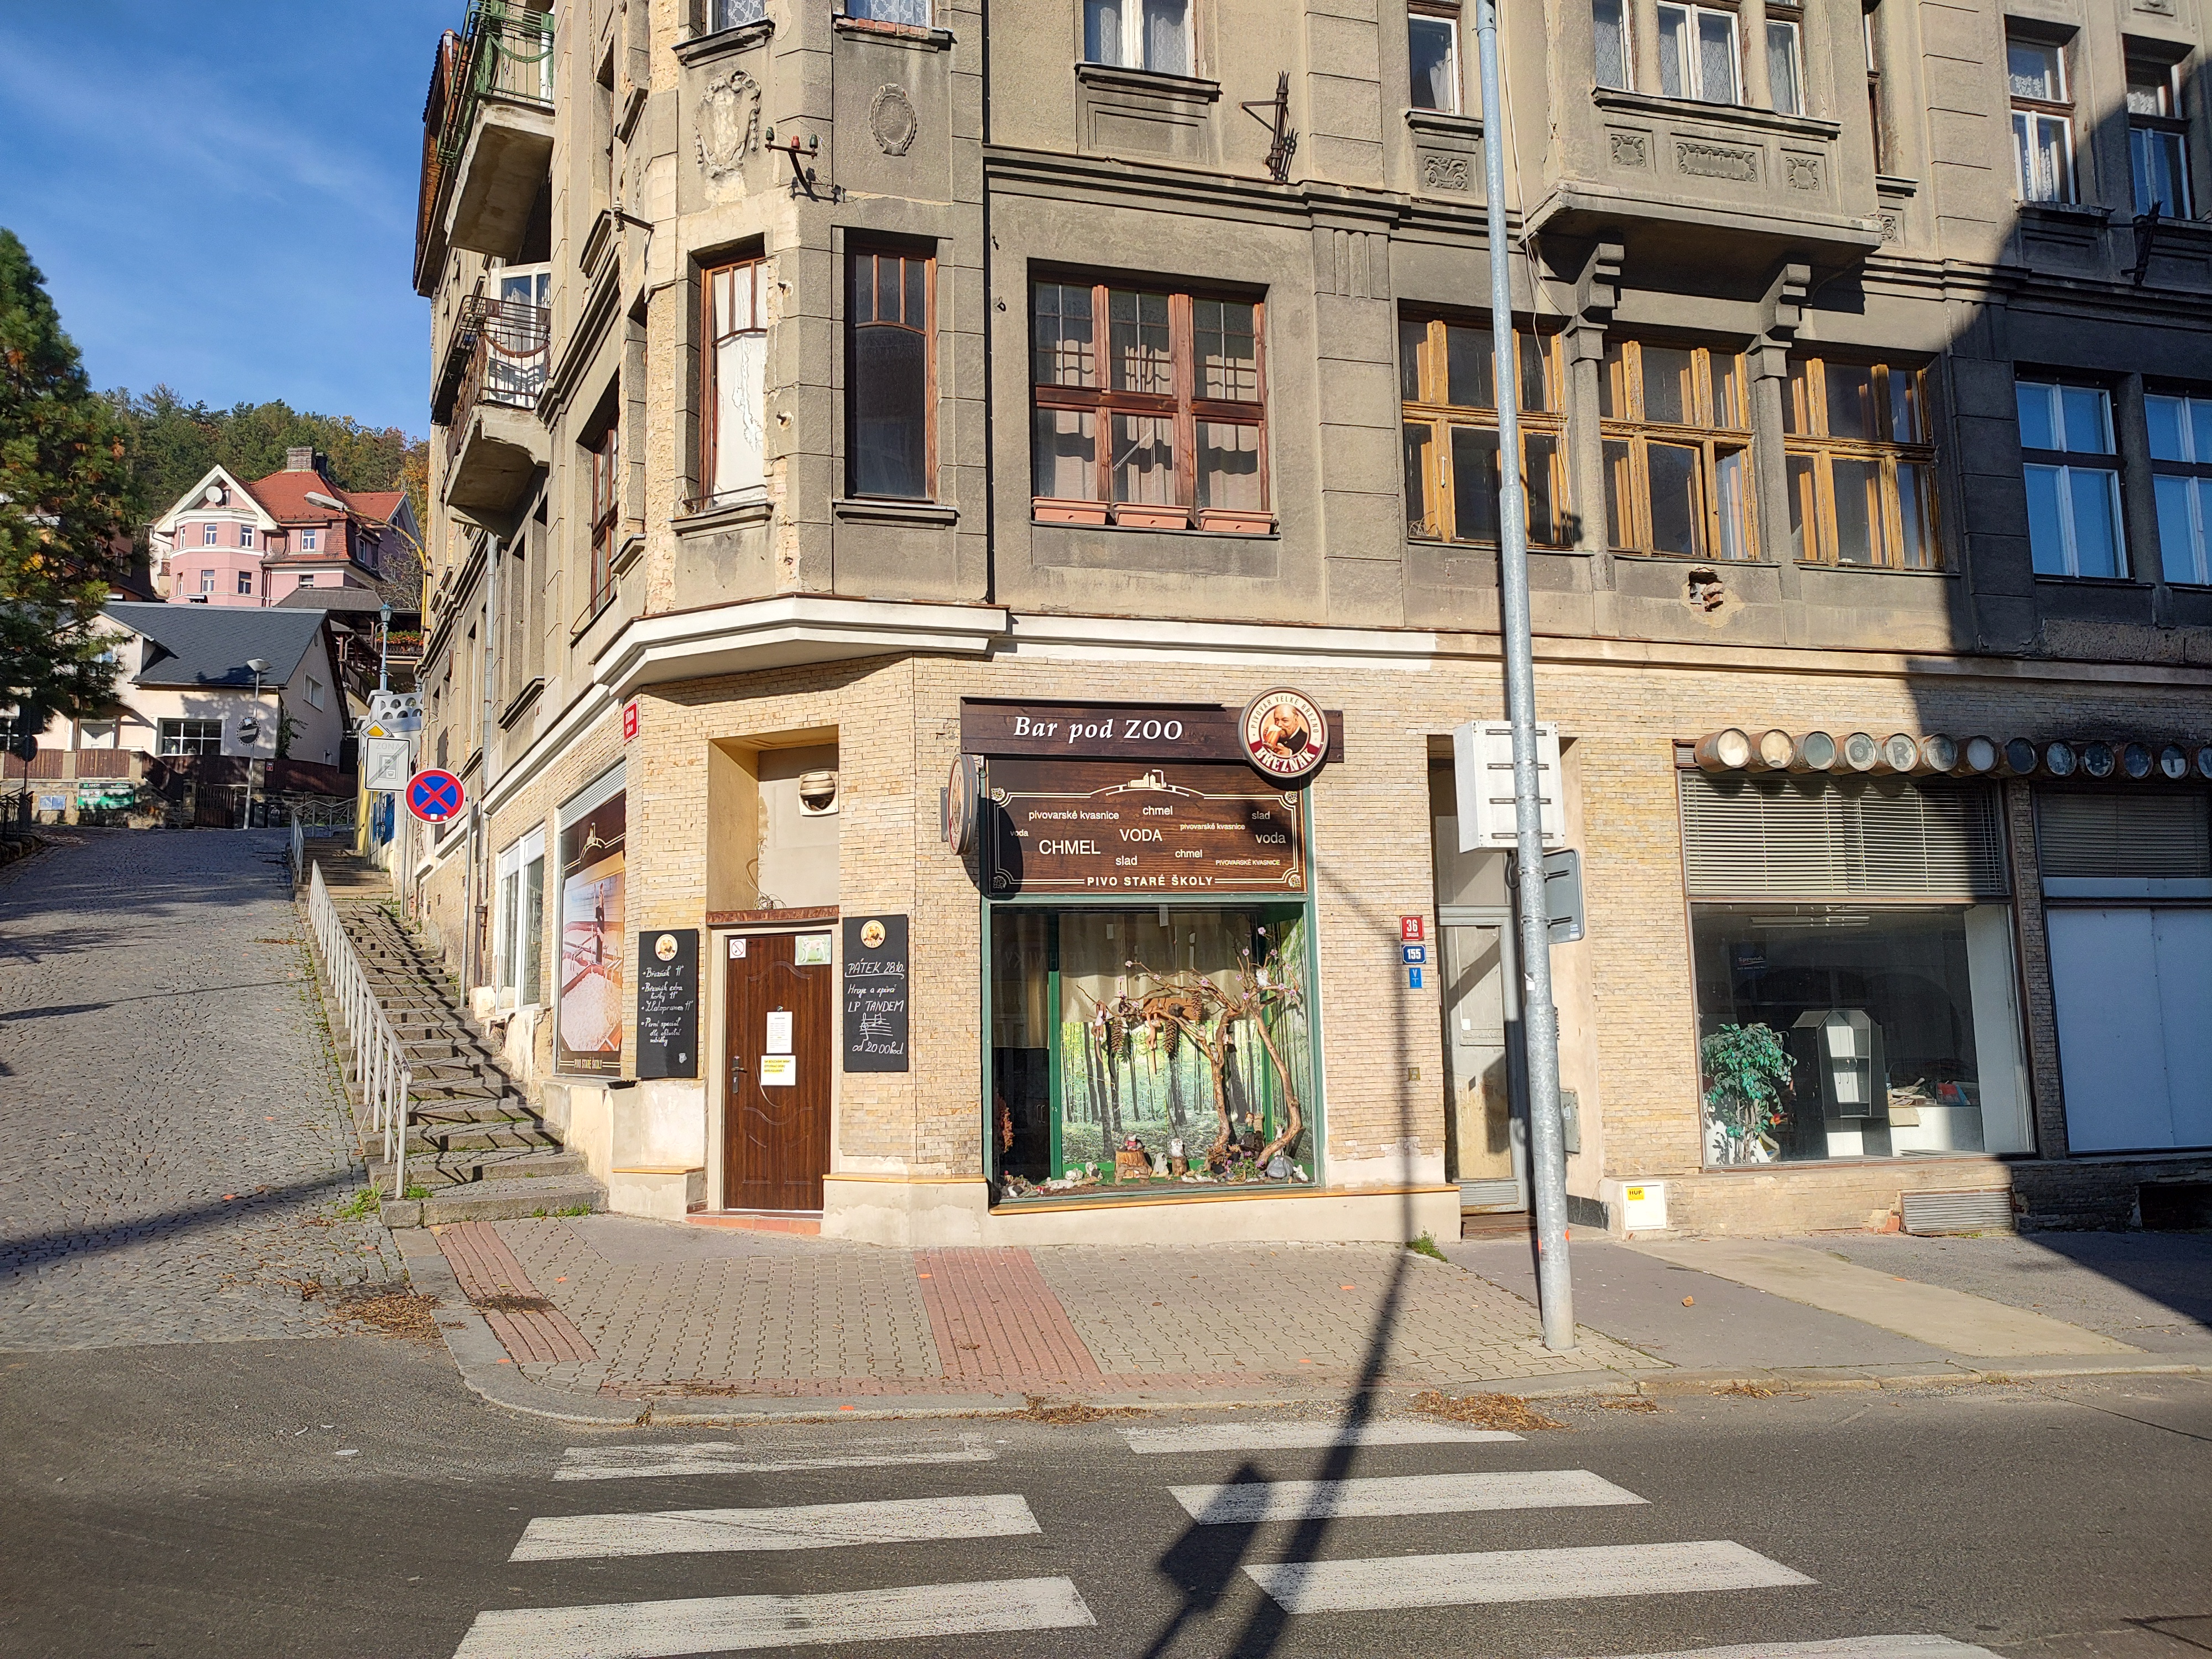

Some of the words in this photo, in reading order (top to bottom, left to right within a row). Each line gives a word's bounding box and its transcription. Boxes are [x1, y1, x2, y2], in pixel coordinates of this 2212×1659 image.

[1251, 699, 1272, 729] PIVOVAR
[1301, 703, 1319, 733] BŘEZNO
[1014, 716, 1058, 737] Bar
[1068, 718, 1114, 744] pod
[1123, 719, 1183, 740] ZOO
[1254, 747, 1316, 772] BŘEZŇÁK
[1029, 809, 1077, 821] pivovarské
[1080, 809, 1119, 820] kvasnice
[1142, 806, 1173, 816] chmel
[1251, 811, 1270, 820] slad
[1119, 828, 1163, 842] VODA
[1255, 832, 1286, 843] voda
[1039, 839, 1101, 855] CHMEL
[1175, 849, 1202, 858] chmel
[1115, 854, 1138, 865] slad
[1087, 877, 1118, 886] PIVO
[1124, 873, 1165, 886] STARÉ
[1171, 874, 1213, 886] ŠKOLY
[1406, 919, 1418, 932] 36
[1407, 948, 1421, 960] 155
[848, 958, 881, 974] PÁTEK
[669, 982, 683, 991] extra
[847, 984, 867, 998] Hraje
[848, 1001, 860, 1012] LP
[865, 1000, 904, 1013] TANDEM
[852, 1040, 864, 1052] od
[865, 1041, 890, 1054] 20:00
